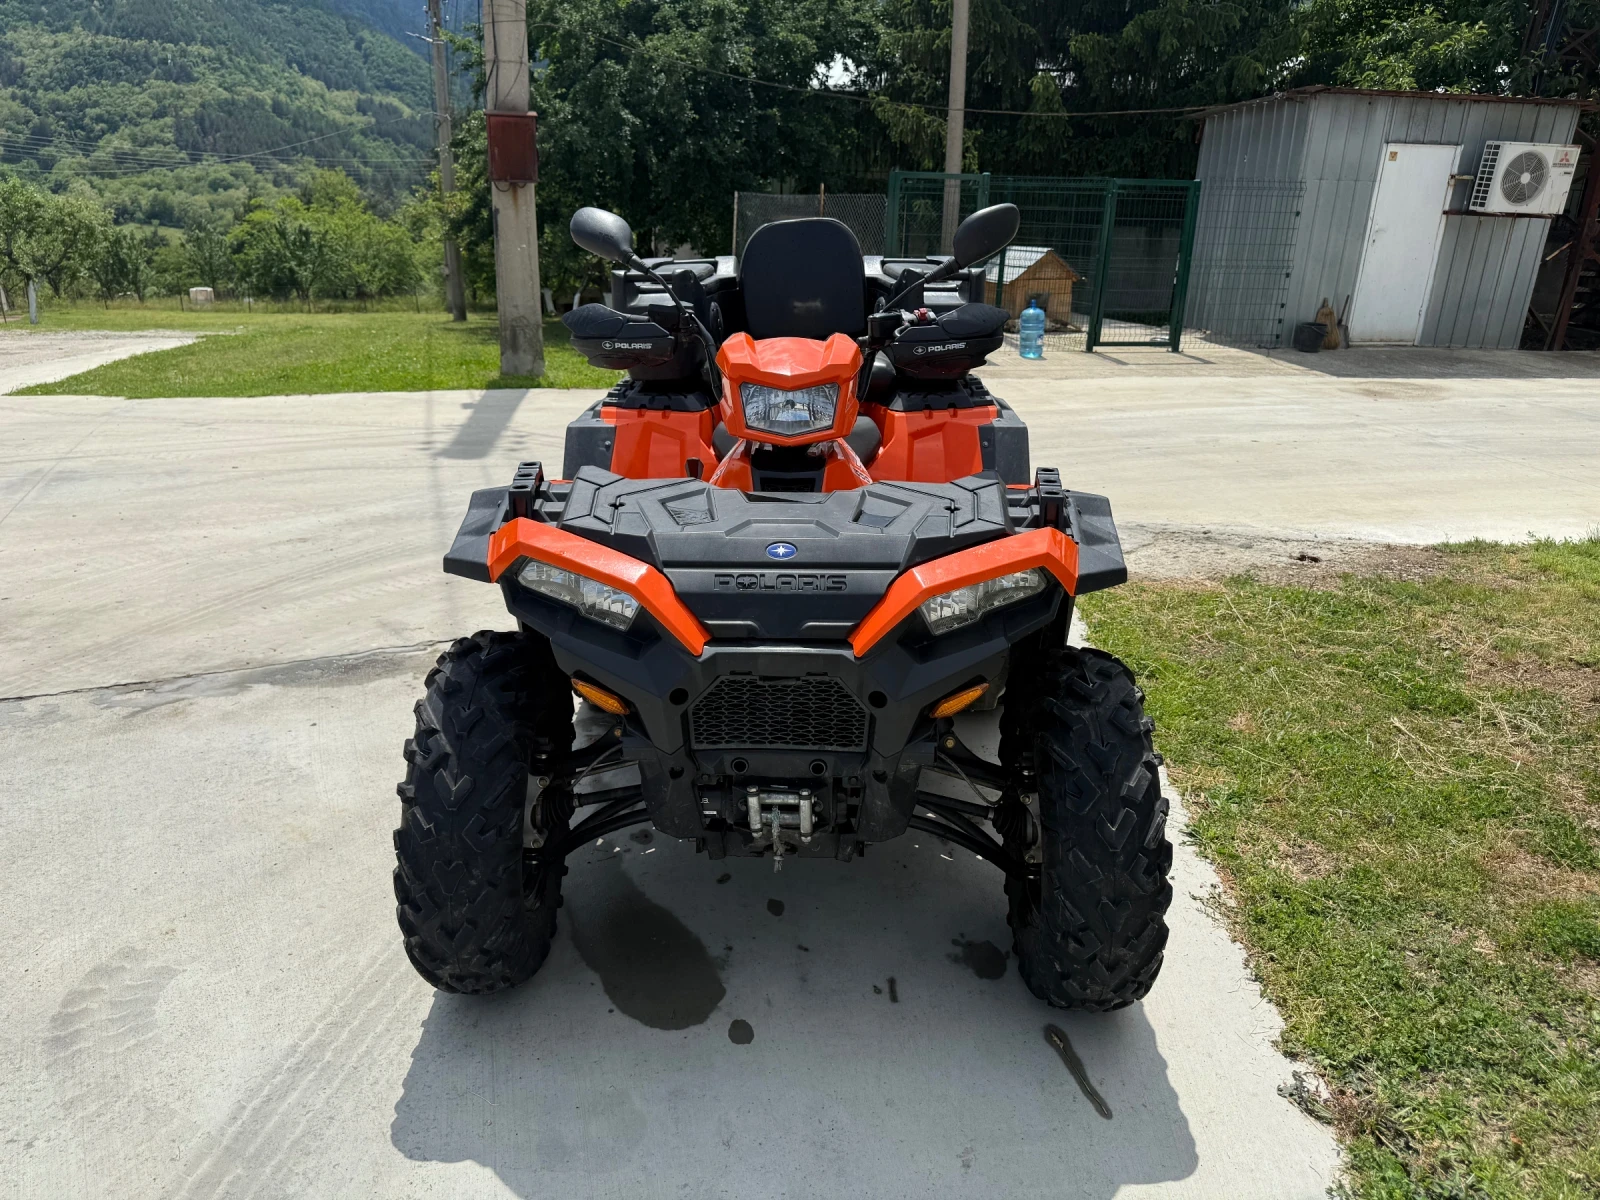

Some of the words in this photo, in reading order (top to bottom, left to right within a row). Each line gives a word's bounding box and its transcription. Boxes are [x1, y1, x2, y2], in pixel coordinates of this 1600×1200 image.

[615, 342, 652, 350] POLARIS
[928, 343, 966, 352] POLARIS
[713, 574, 847, 591] POLARIS
